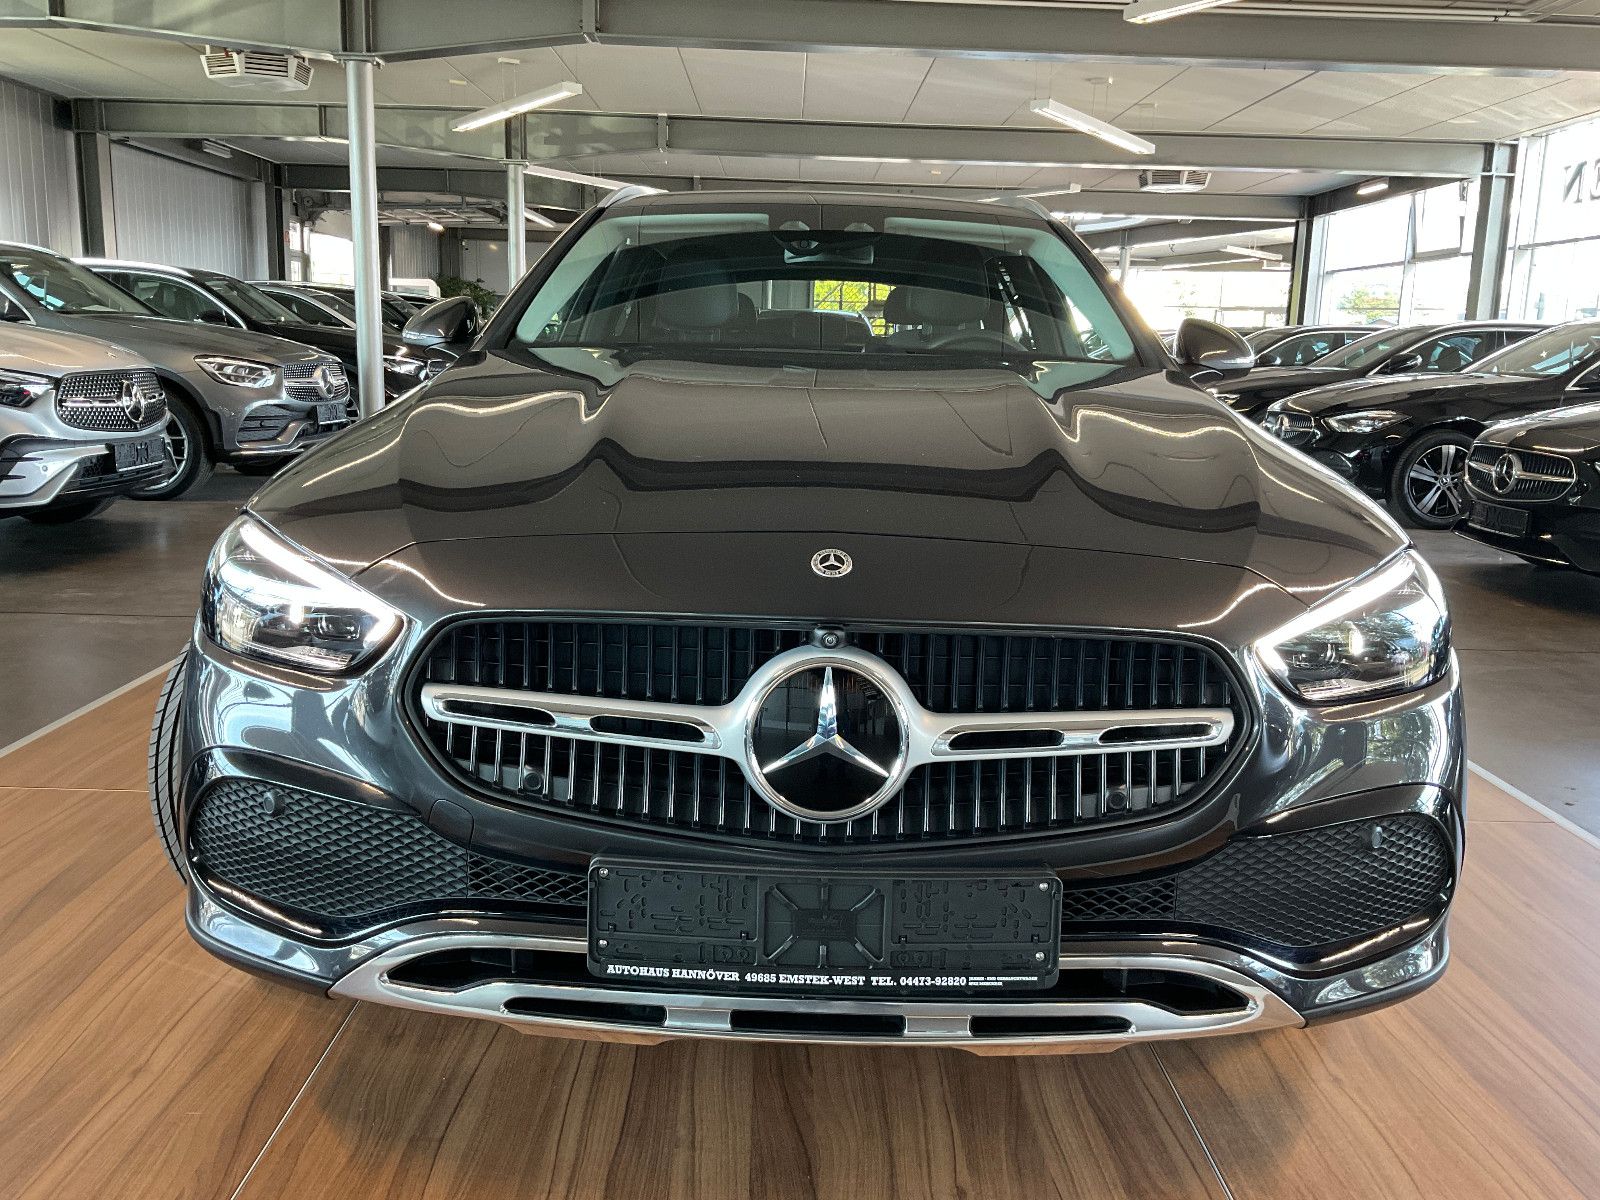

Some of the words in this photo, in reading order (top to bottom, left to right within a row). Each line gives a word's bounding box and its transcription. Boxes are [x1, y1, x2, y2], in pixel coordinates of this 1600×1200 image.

[606, 964, 670, 977] AUTOHAUS
[671, 968, 740, 981] HANNÖVER
[744, 972, 777, 983] 49685
[778, 973, 866, 985] EMSTEK-WEST
[870, 976, 897, 986] TEL.
[899, 976, 967, 986] 04473-92820
